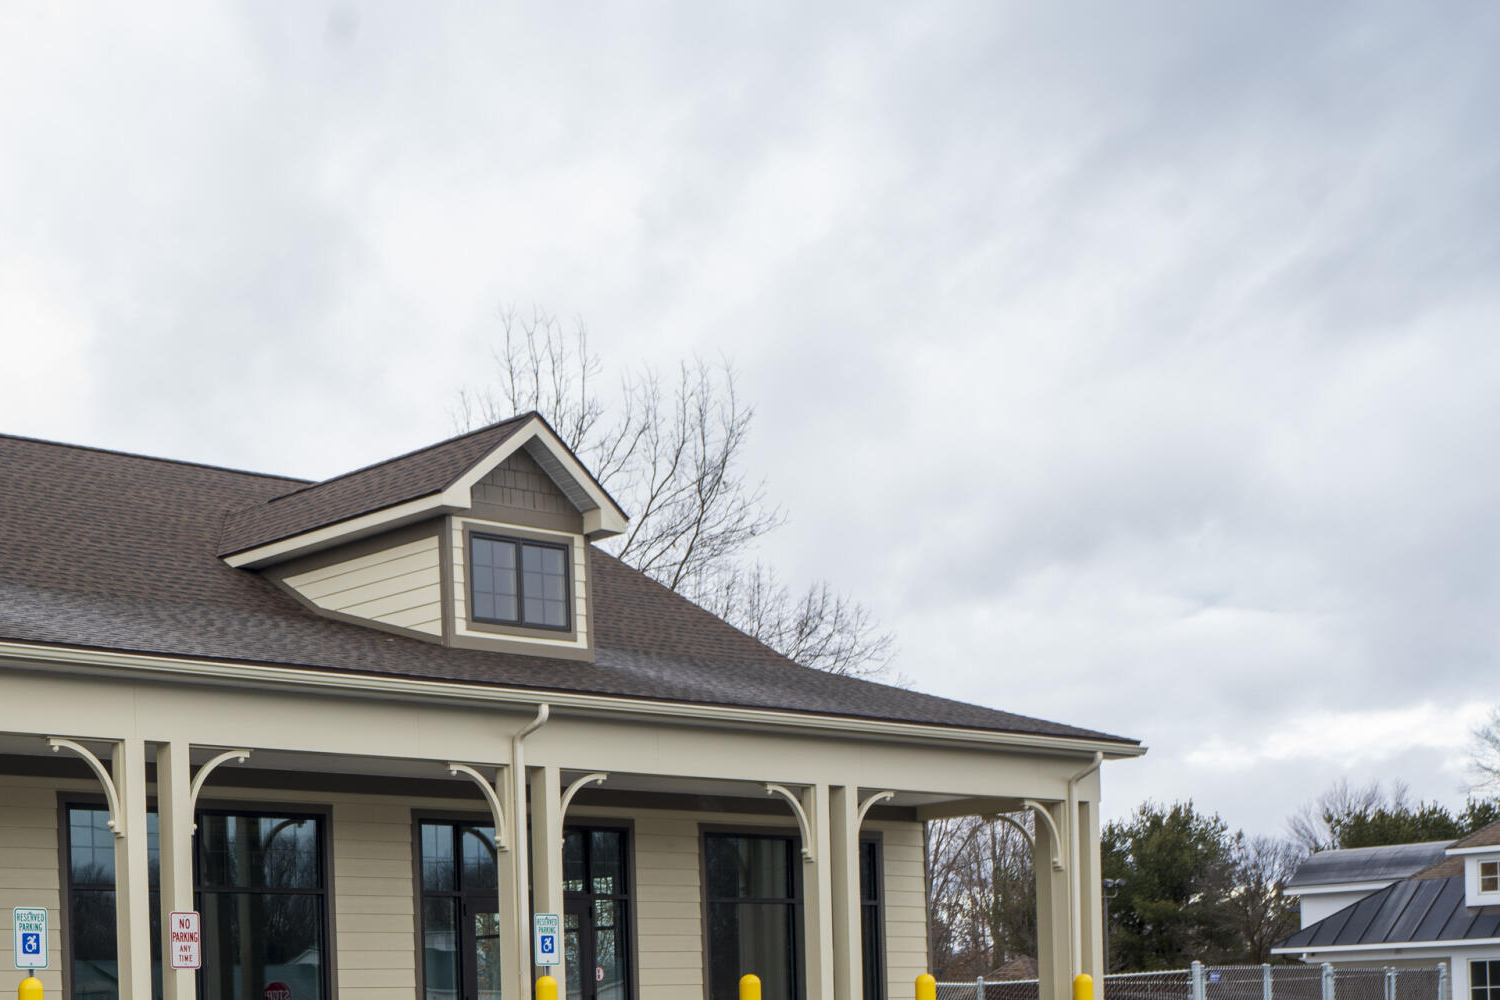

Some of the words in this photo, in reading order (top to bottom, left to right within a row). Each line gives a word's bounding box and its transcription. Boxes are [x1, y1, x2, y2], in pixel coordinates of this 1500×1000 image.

[16, 912, 45, 922] RESERVED
[179, 918, 191, 930] NO
[535, 918, 558, 926] RESERVED
[19, 922, 43, 932] PARKING
[538, 926, 556, 934] PARKING
[172, 931, 198, 943] PARKING
[179, 944, 192, 953] ANY
[179, 954, 193, 963] TIME
